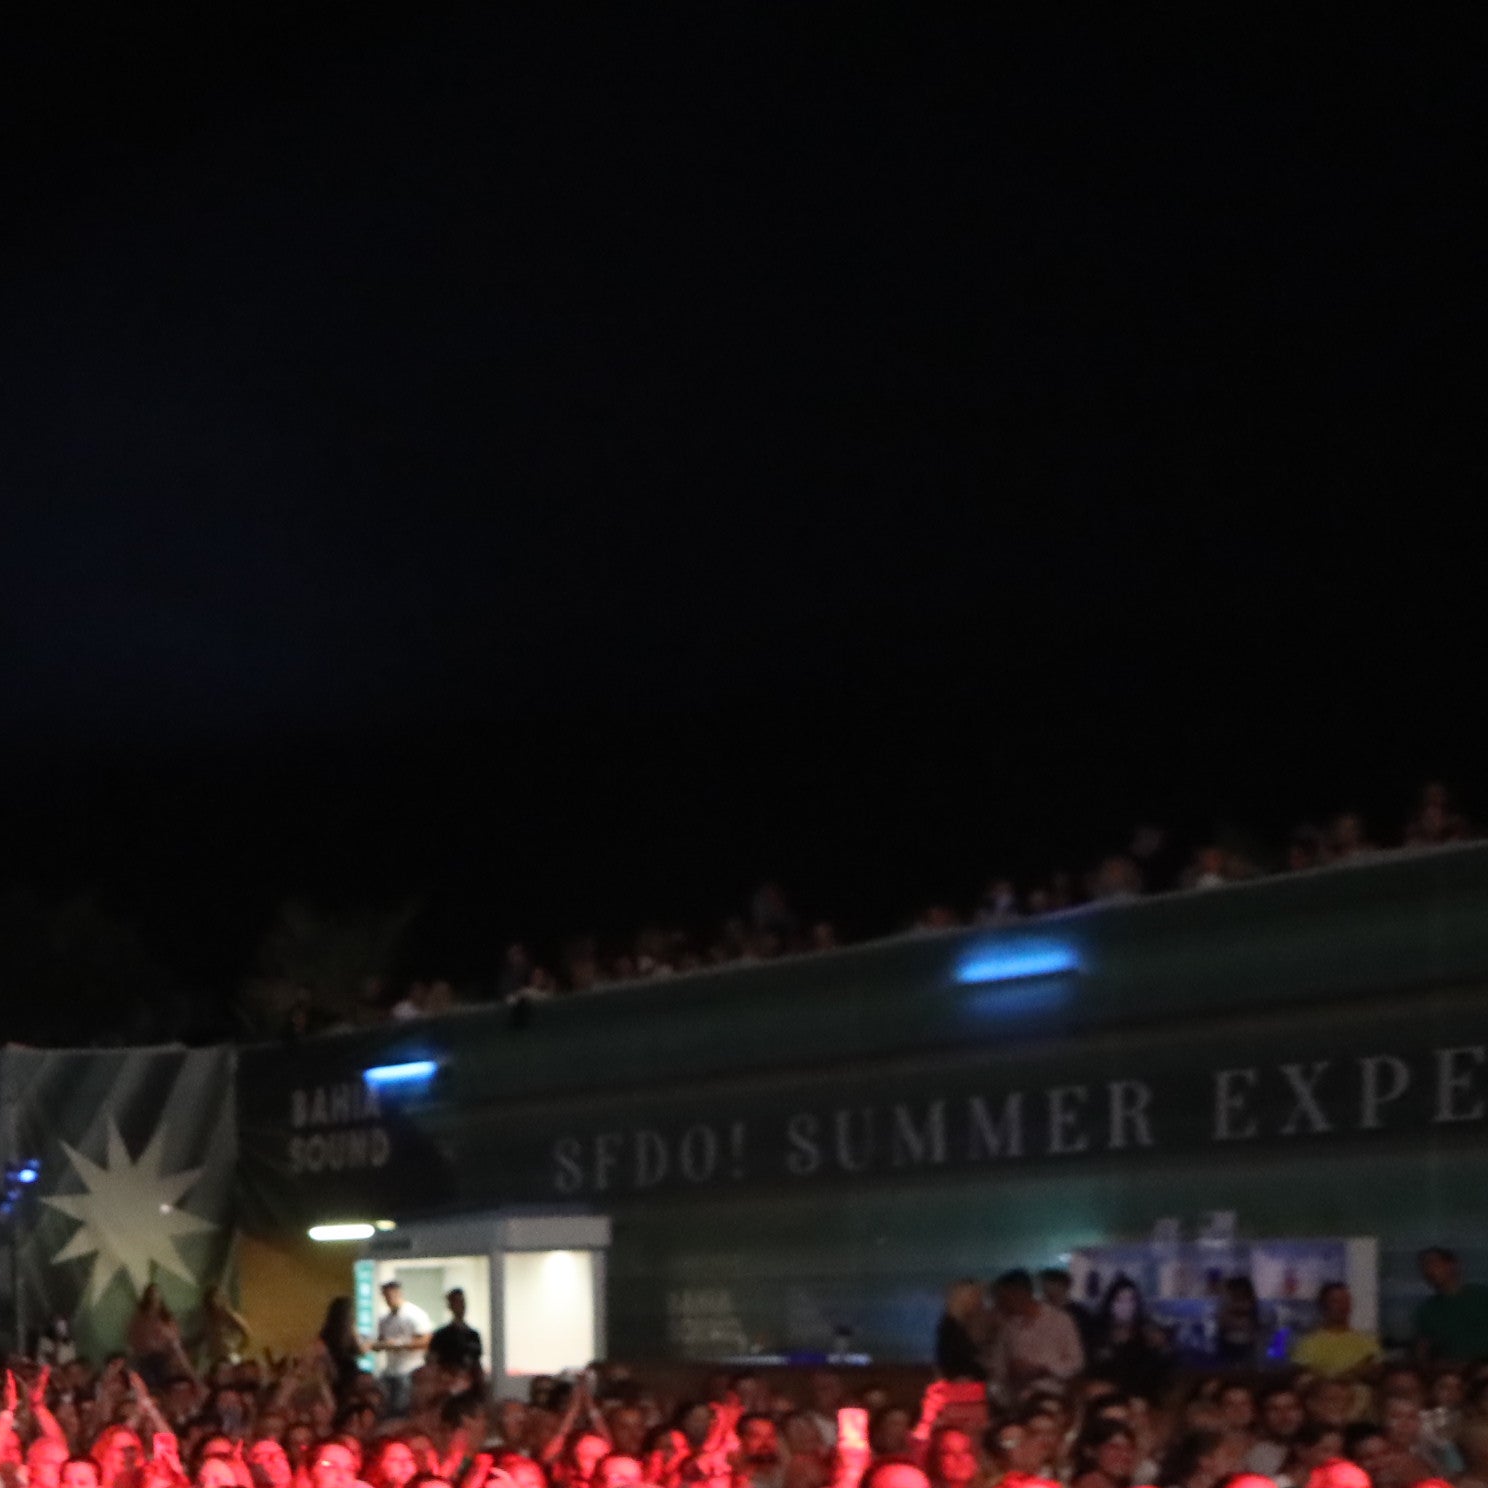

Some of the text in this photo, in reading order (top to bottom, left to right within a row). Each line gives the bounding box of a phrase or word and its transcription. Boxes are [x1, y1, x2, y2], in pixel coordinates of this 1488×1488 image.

[287, 1127, 391, 1174] SOUND
[552, 1043, 1488, 1194] SFDO! SUMMER EXPE
